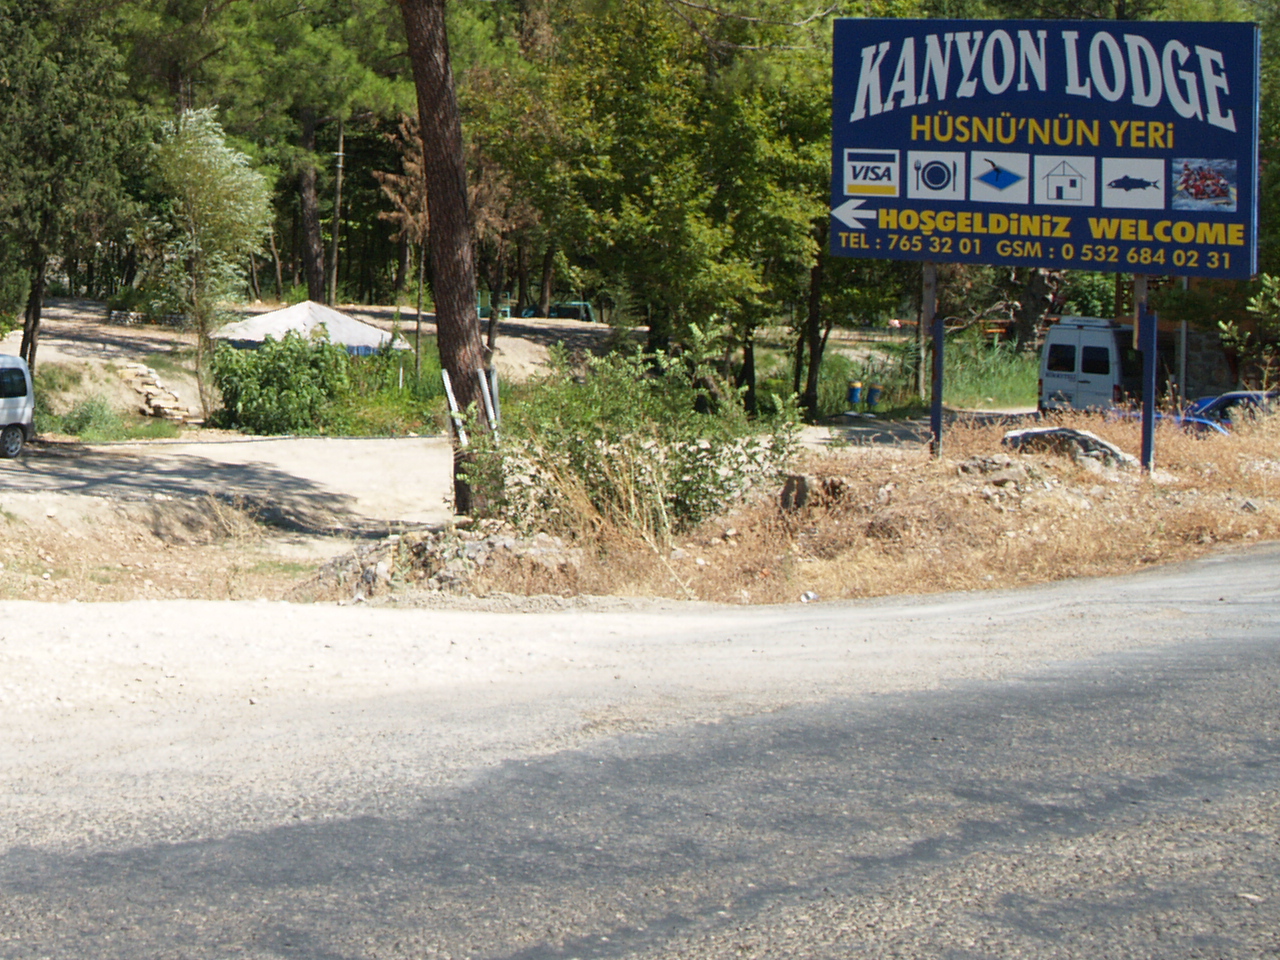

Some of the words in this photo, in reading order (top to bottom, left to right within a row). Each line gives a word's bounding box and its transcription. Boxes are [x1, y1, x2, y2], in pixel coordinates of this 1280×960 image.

[849, 29, 1048, 123] KANYON
[1061, 30, 1237, 133] LODGE
[910, 111, 1100, 147] HÜSNÜ'NÜN
[851, 165, 893, 182] VISA
[1089, 217, 1245, 246] WELCOME
[838, 232, 869, 249] TEL
[888, 234, 922, 252] 765
[929, 237, 953, 253] 32
[959, 238, 981, 255] 01
[996, 240, 1042, 258] GSM
[1061, 243, 1074, 260] 0
[1080, 244, 1119, 263] 532
[1126, 247, 1165, 265] 684
[1172, 249, 1199, 267] 02
[1206, 251, 1231, 269] 31
